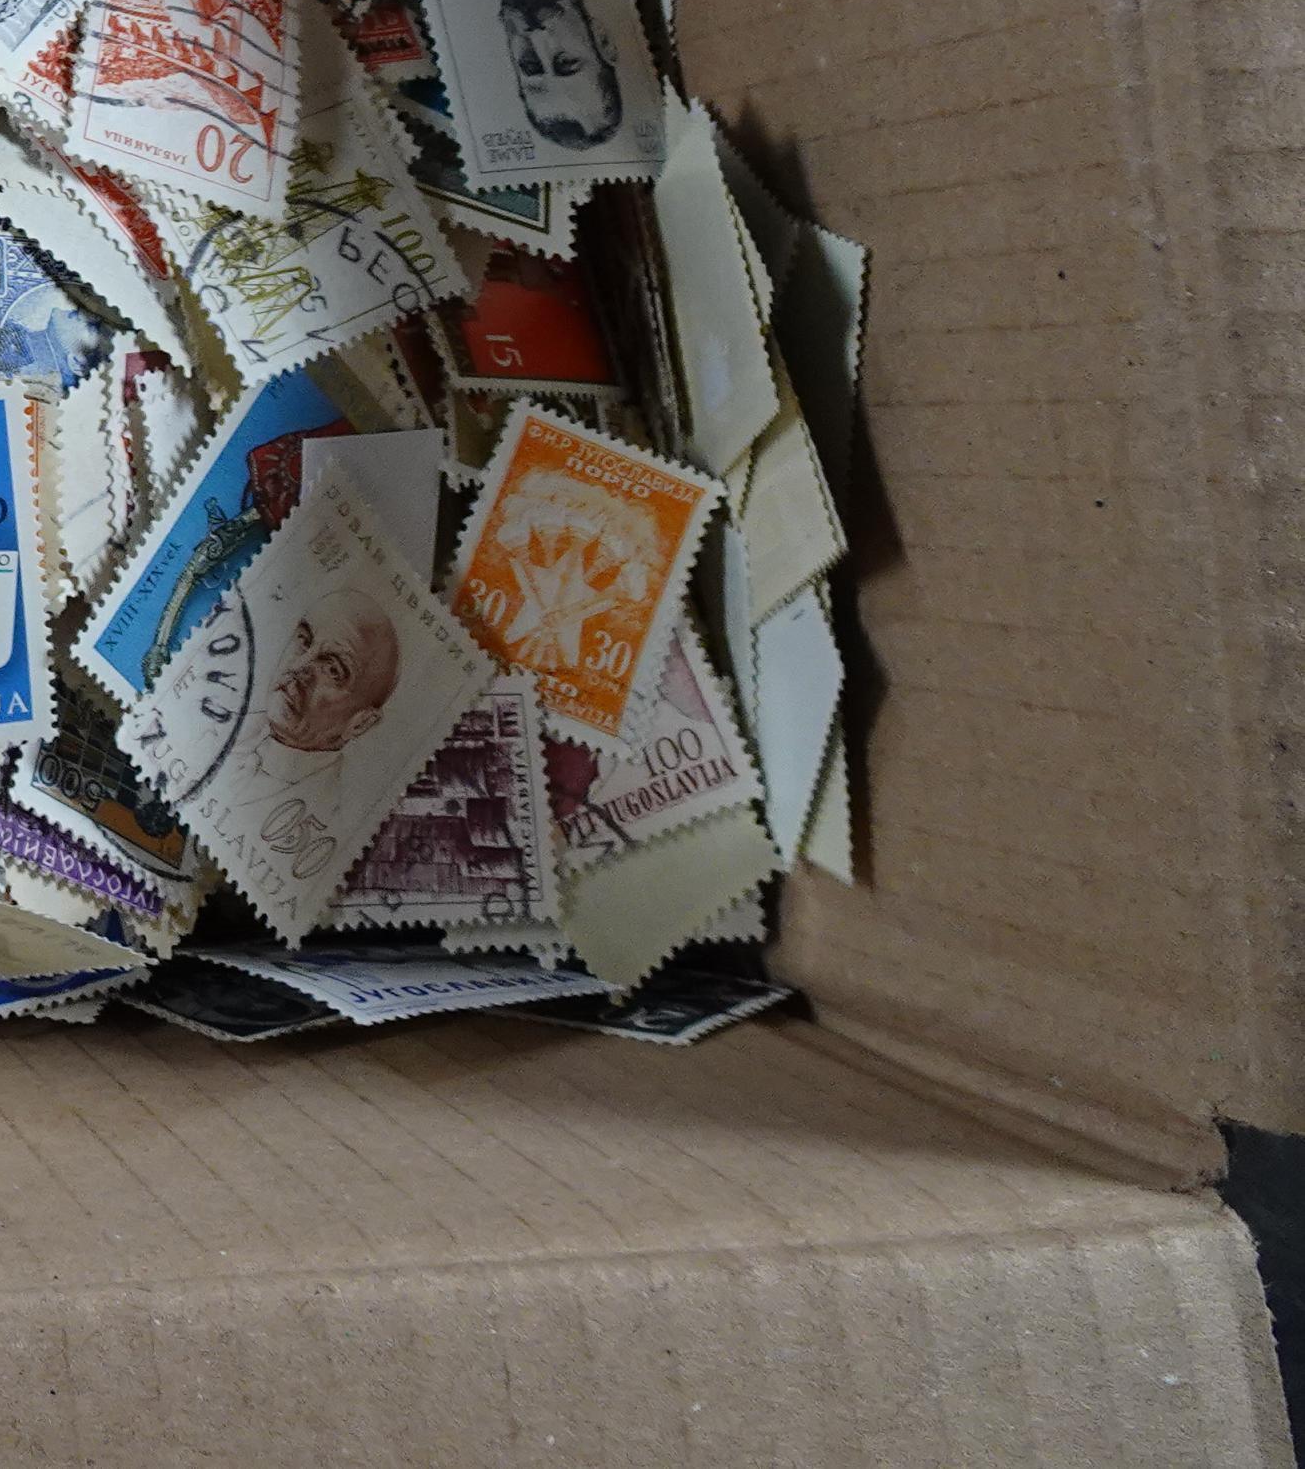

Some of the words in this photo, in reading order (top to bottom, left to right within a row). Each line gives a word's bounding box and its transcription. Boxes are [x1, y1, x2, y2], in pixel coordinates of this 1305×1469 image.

[189, 120, 264, 185] 20
[483, 325, 523, 374] 15
[584, 628, 633, 678] 30
